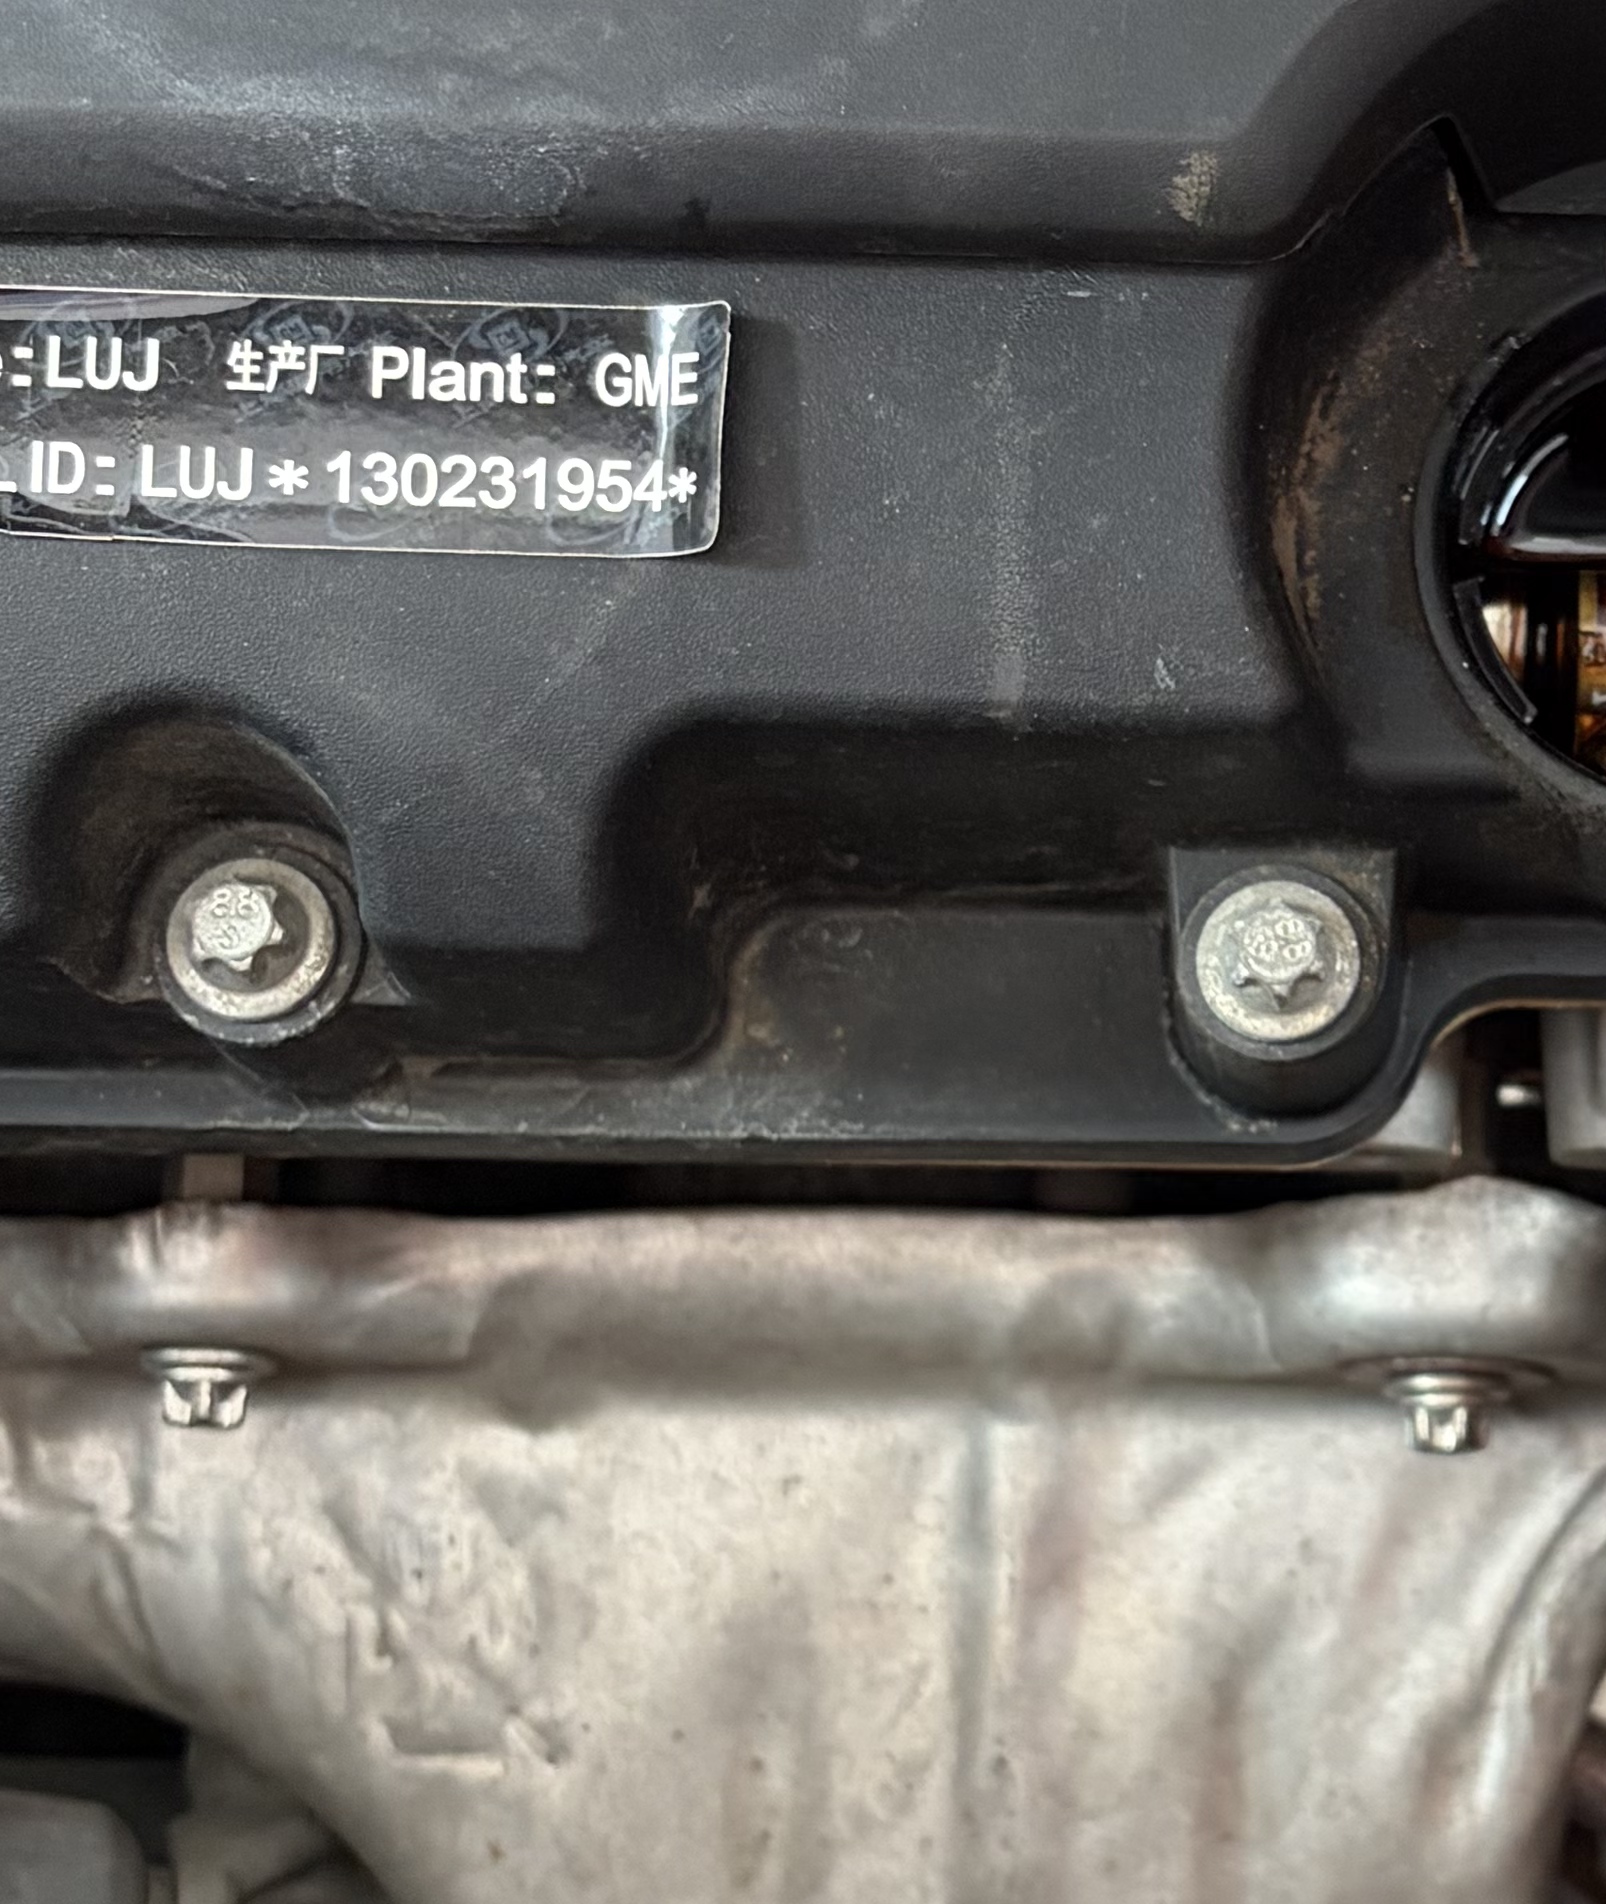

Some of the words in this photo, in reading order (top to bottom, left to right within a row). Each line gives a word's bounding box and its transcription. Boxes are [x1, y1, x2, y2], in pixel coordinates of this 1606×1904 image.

[0, 335, 160, 391] :LUJ
[226, 339, 345, 394] 生产厂
[371, 345, 556, 405] Plant:
[595, 351, 699, 407] GME
